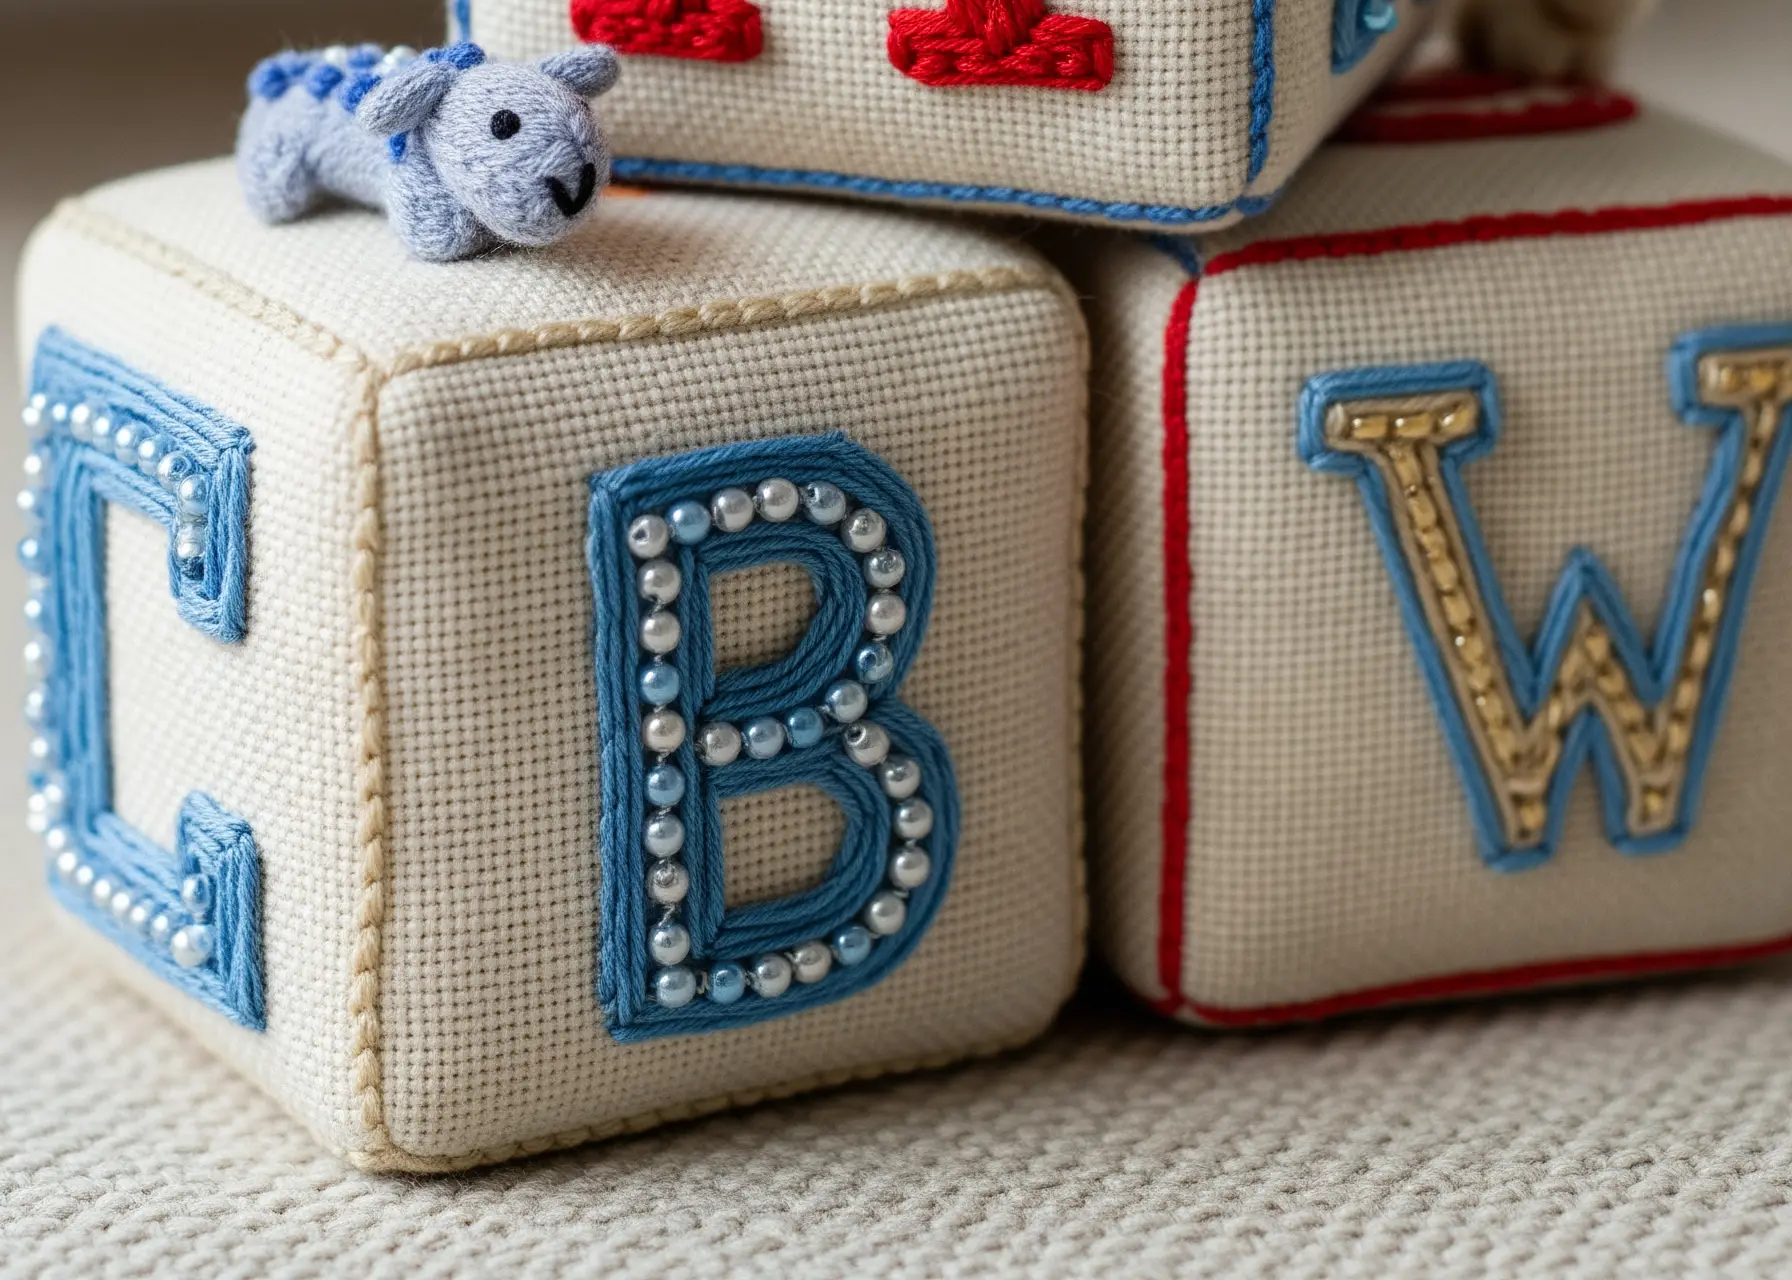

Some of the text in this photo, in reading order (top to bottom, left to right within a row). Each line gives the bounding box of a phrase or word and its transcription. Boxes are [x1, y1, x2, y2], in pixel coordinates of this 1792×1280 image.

[16, 325, 267, 1031] C
[588, 430, 960, 1044] B
[1297, 323, 1792, 872] W
